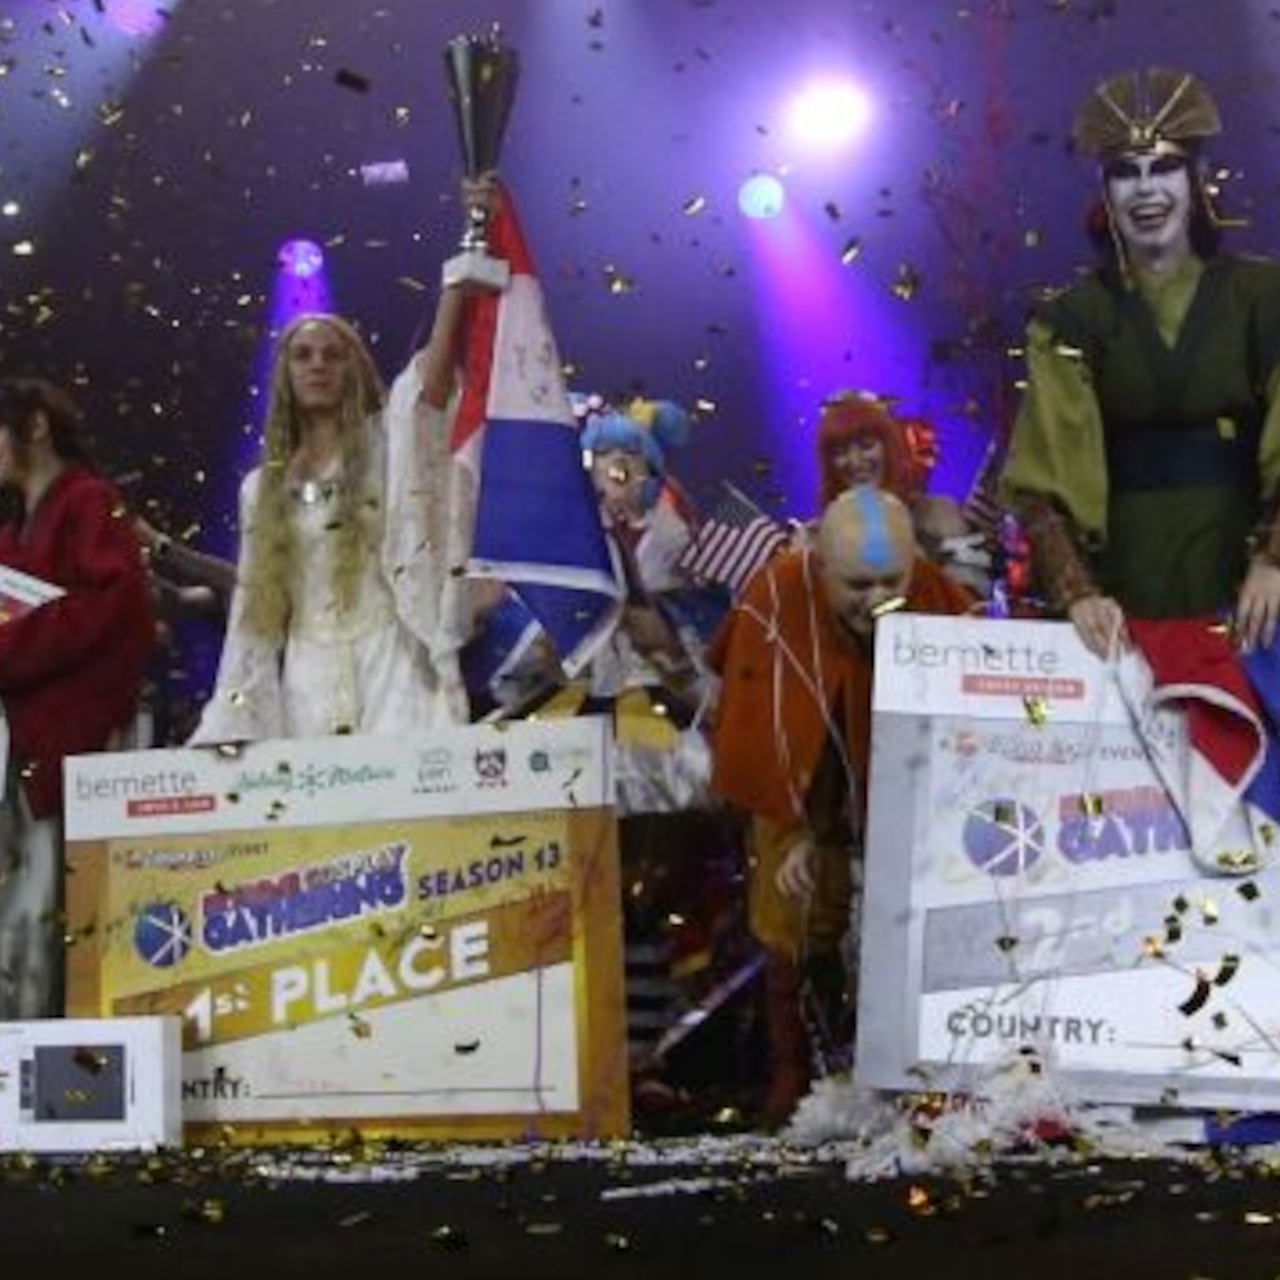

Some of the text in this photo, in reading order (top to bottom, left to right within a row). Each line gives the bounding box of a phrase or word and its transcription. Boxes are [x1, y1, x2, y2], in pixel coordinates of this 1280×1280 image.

[893, 633, 1059, 671] bernette
[76, 770, 197, 800] bernette
[419, 841, 561, 901] SEASON 13
[272, 920, 490, 1023] PLACE
[946, 1010, 1116, 1042] COUNTRY:
